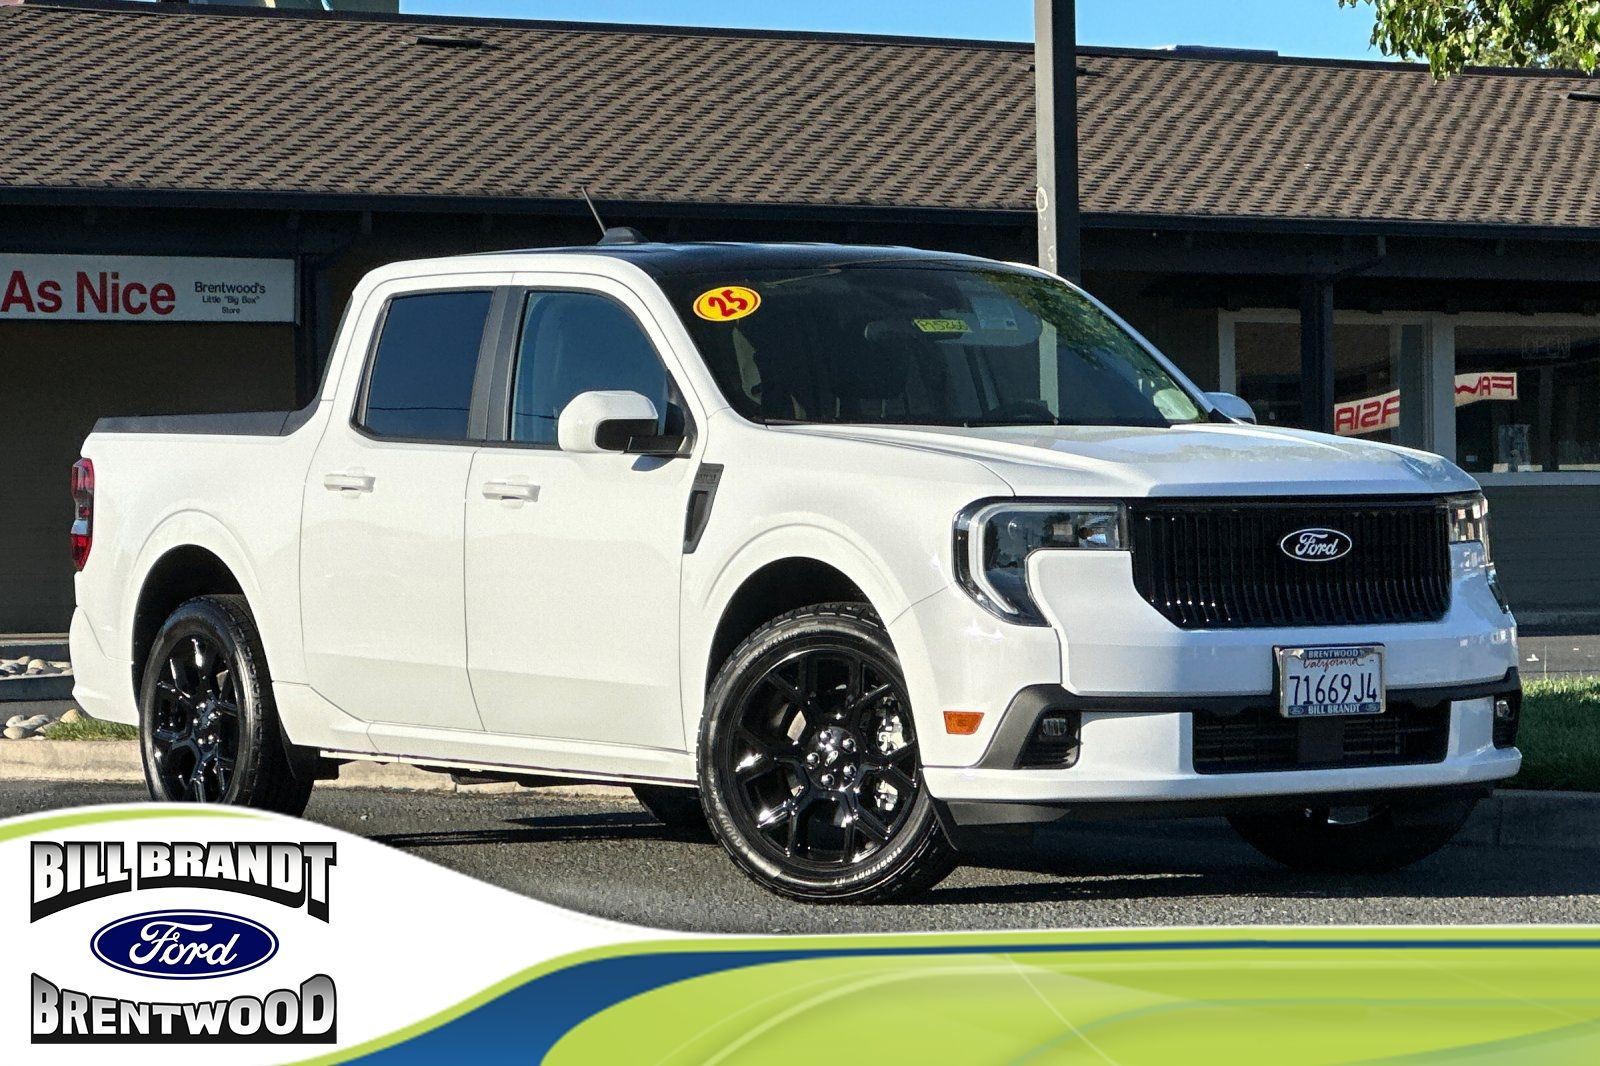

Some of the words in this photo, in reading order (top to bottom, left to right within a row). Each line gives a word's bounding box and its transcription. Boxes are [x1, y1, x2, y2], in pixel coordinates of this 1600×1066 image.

[0, 270, 62, 314] As
[76, 271, 176, 315] Nice
[194, 281, 266, 294] Brentwood's
[202, 295, 221, 304] Little
[708, 289, 748, 318] 25
[221, 306, 241, 314] Store
[1295, 531, 1339, 556] Ford
[1308, 649, 1359, 658] BRENTWOOD
[1289, 672, 1378, 705] 71669J4
[1308, 704, 1325, 715] BILL
[1327, 703, 1361, 714] BRANDT
